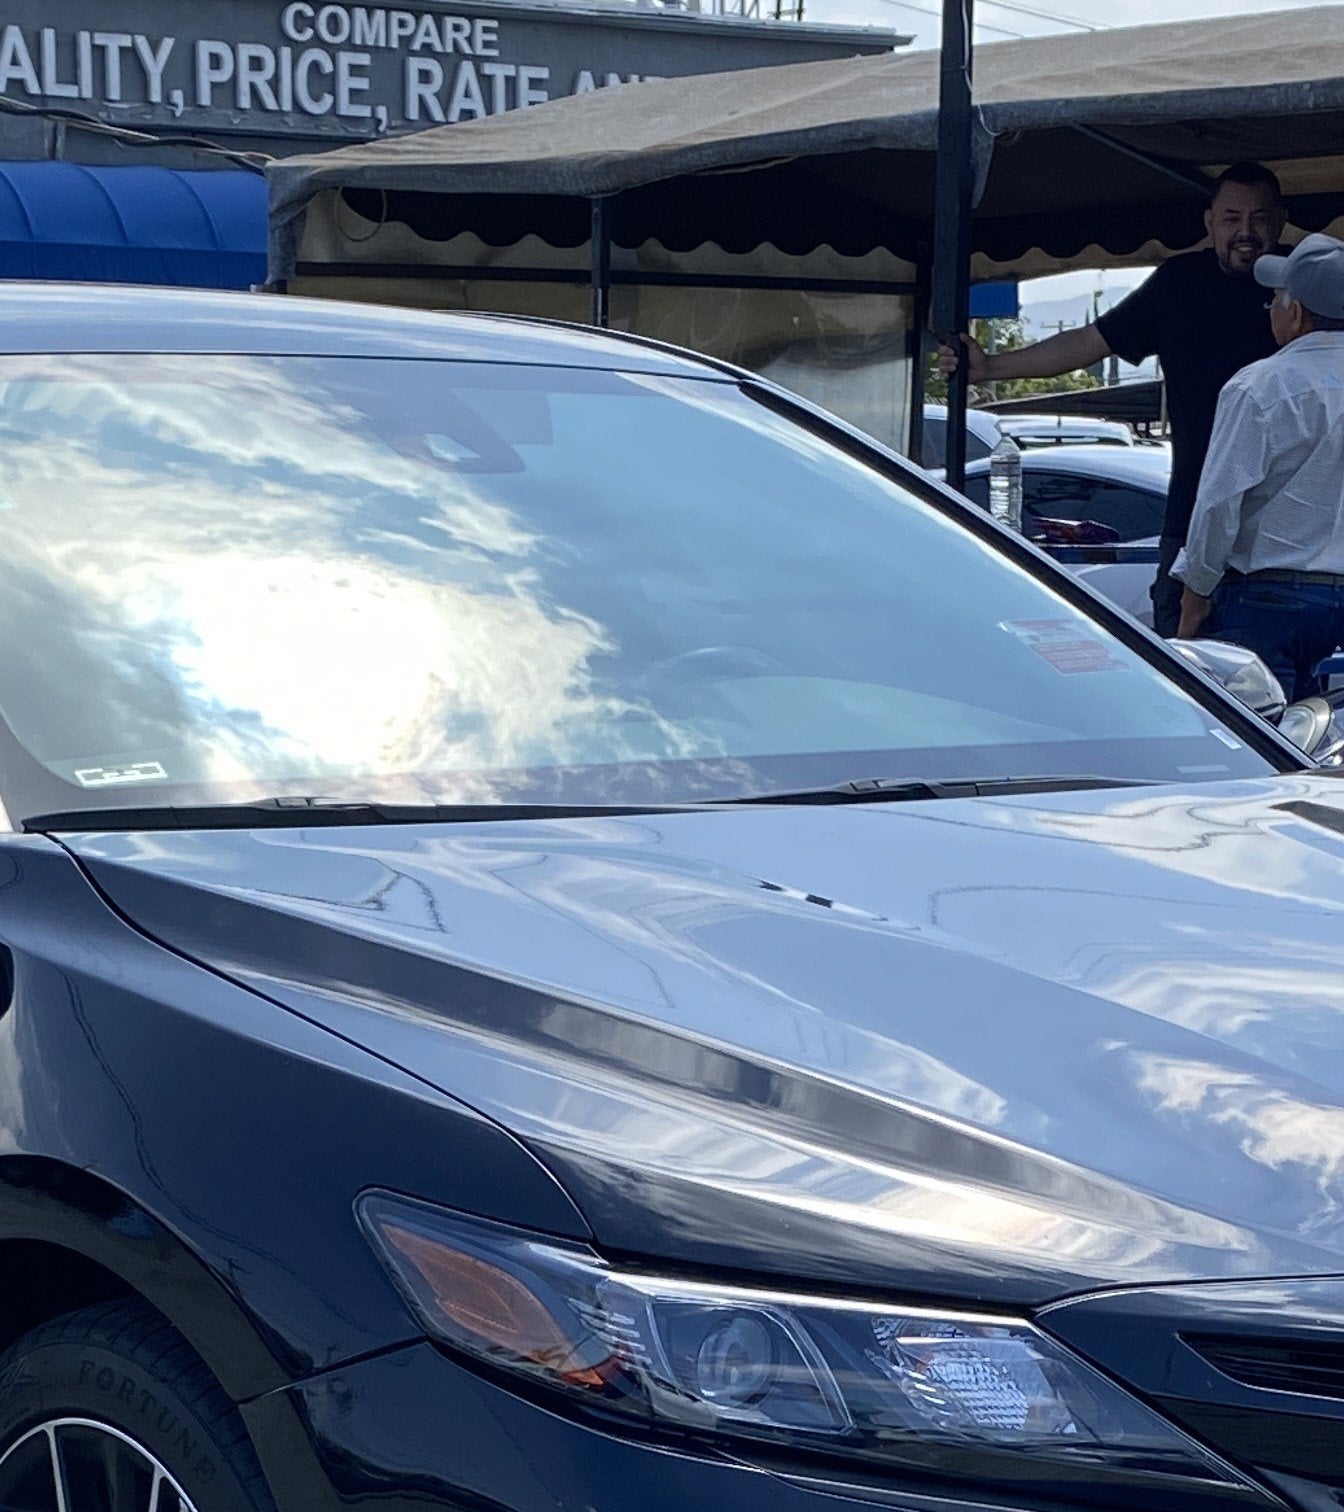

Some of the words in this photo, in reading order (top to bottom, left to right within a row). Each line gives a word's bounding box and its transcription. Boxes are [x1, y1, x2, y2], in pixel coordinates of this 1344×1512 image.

[281, 2, 500, 56] COMPARE
[195, 39, 388, 133] PRICE,
[406, 55, 550, 122] RATE
[78, 1358, 217, 1484] FORTUNE
